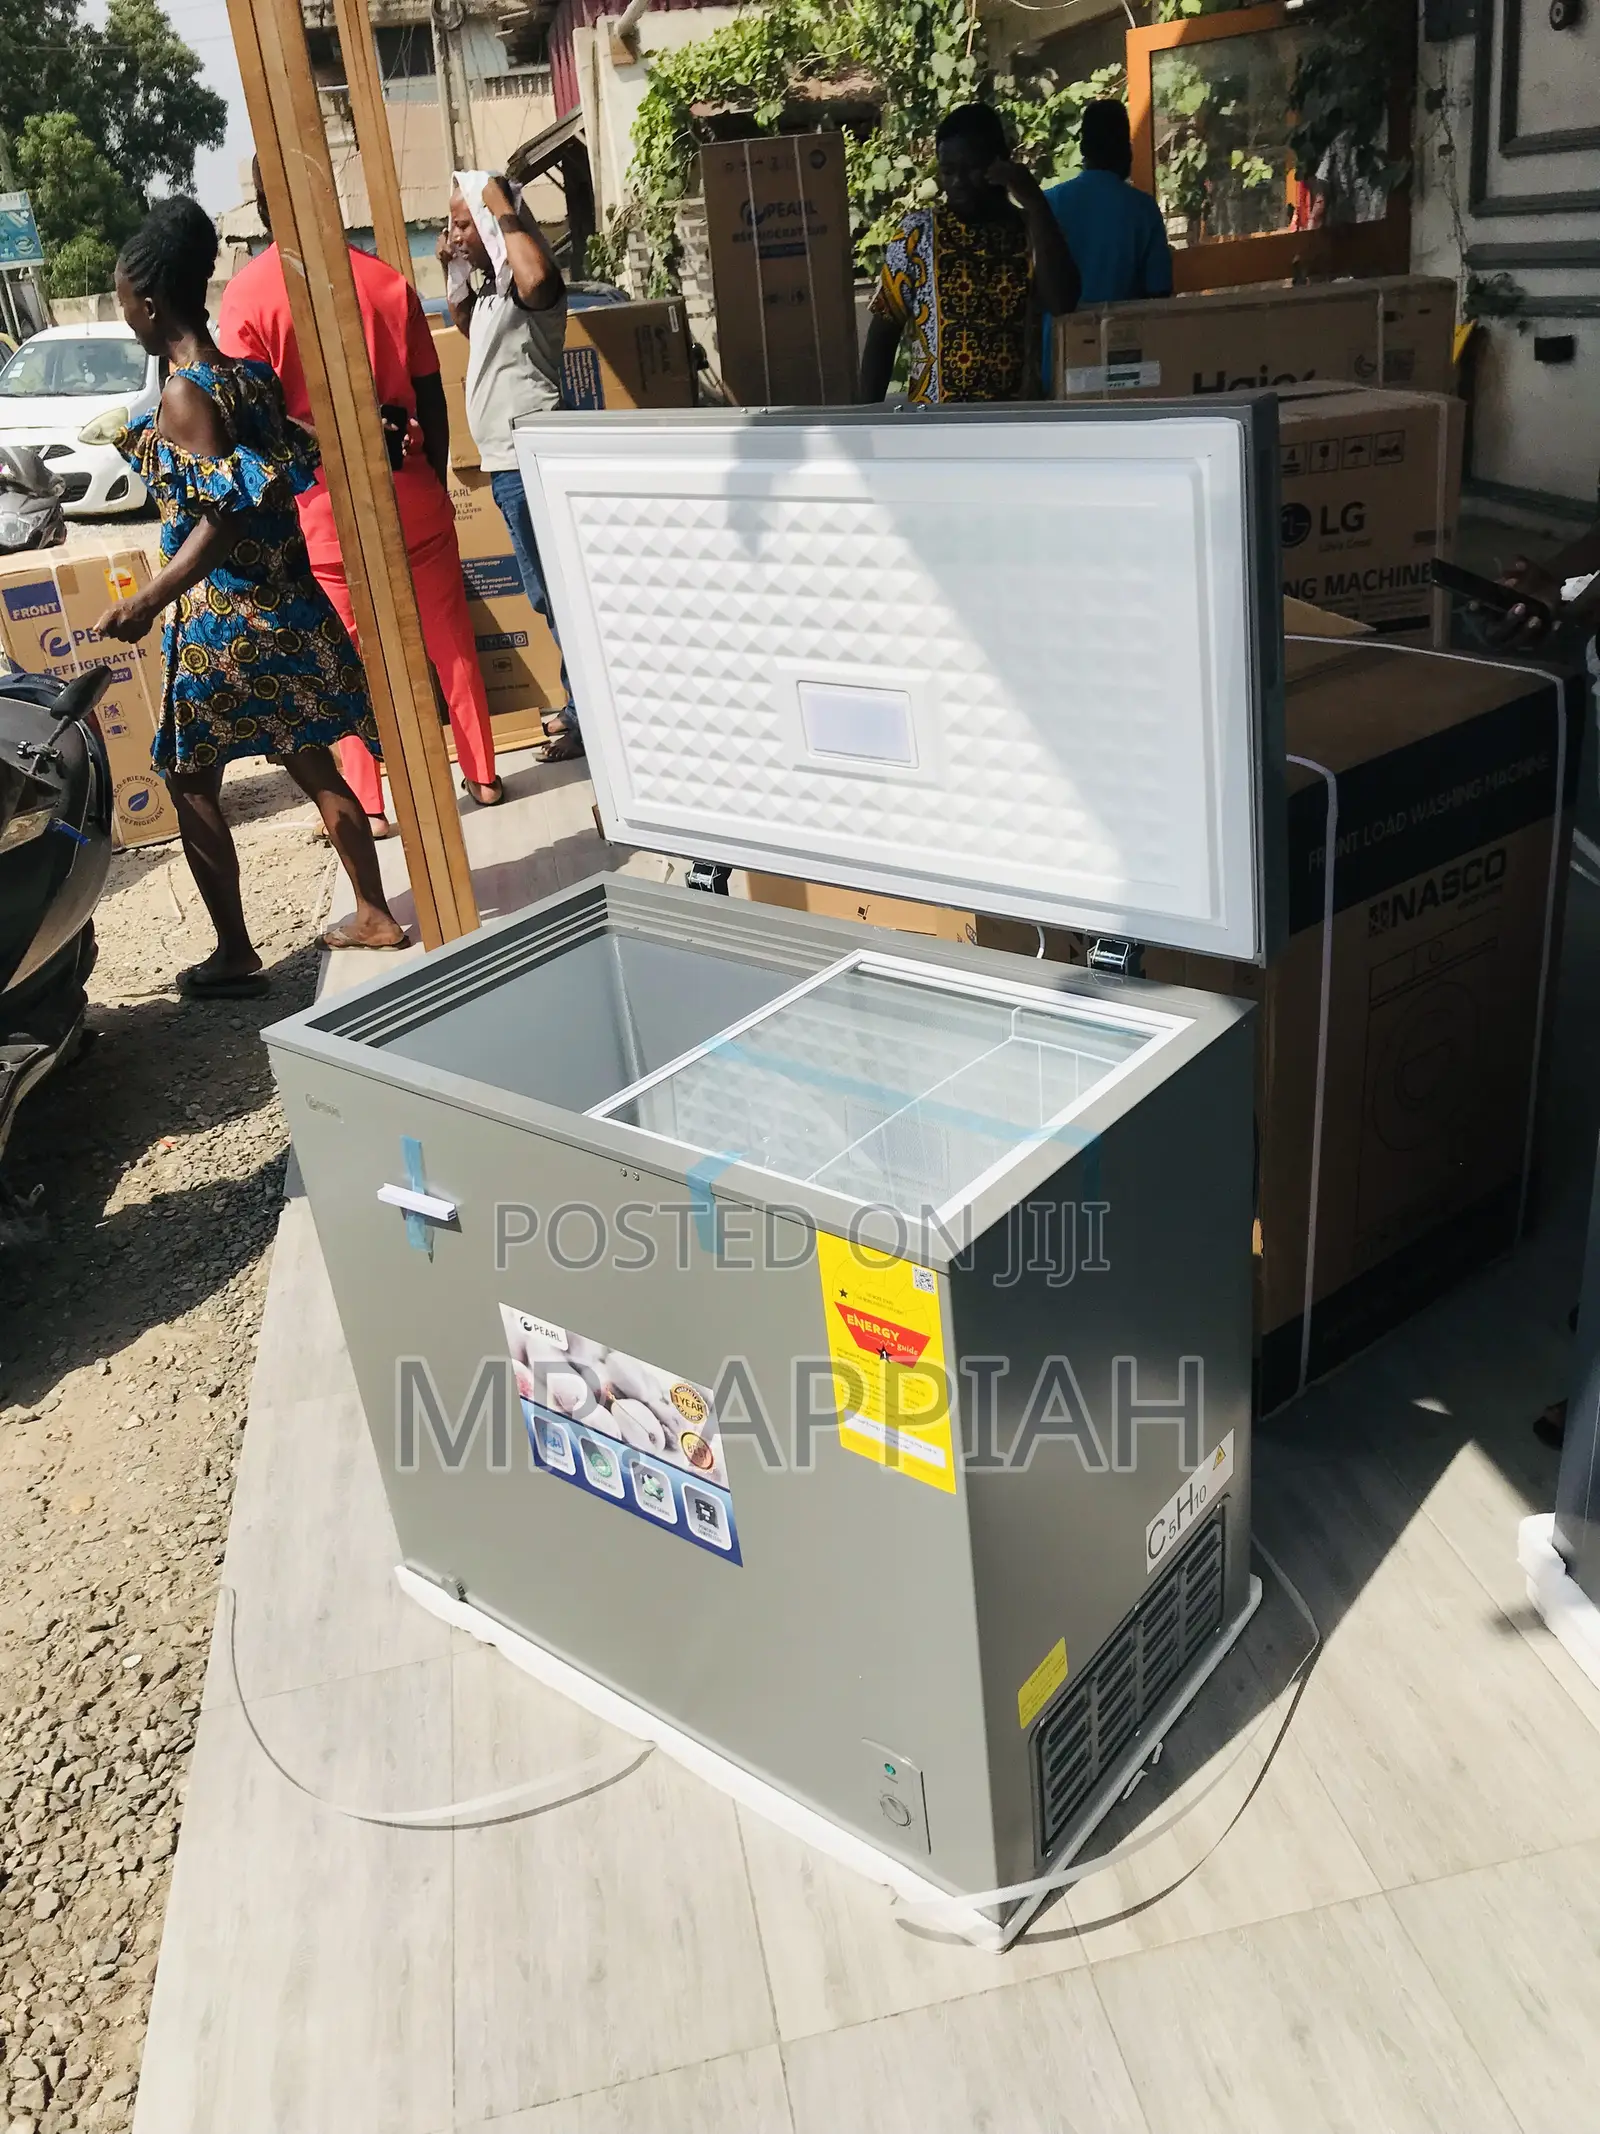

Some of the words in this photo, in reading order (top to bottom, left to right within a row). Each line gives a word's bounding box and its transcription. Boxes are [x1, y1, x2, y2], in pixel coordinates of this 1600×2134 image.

[1320, 502, 1366, 536] LG
[1324, 561, 1432, 597] MACHINE
[12, 602, 58, 620] FRONT
[1363, 811, 1408, 846] LOAD
[1411, 777, 1482, 825] WASHING
[1484, 750, 1551, 794] MACHINE
[119, 806, 165, 827] REFRIGERANT
[1391, 848, 1508, 928] NASCO
[533, 1323, 563, 1343] PEARL
[846, 1312, 900, 1342] ENERGY
[896, 1343, 919, 1356] guide
[681, 1397, 704, 1414] YEAR
